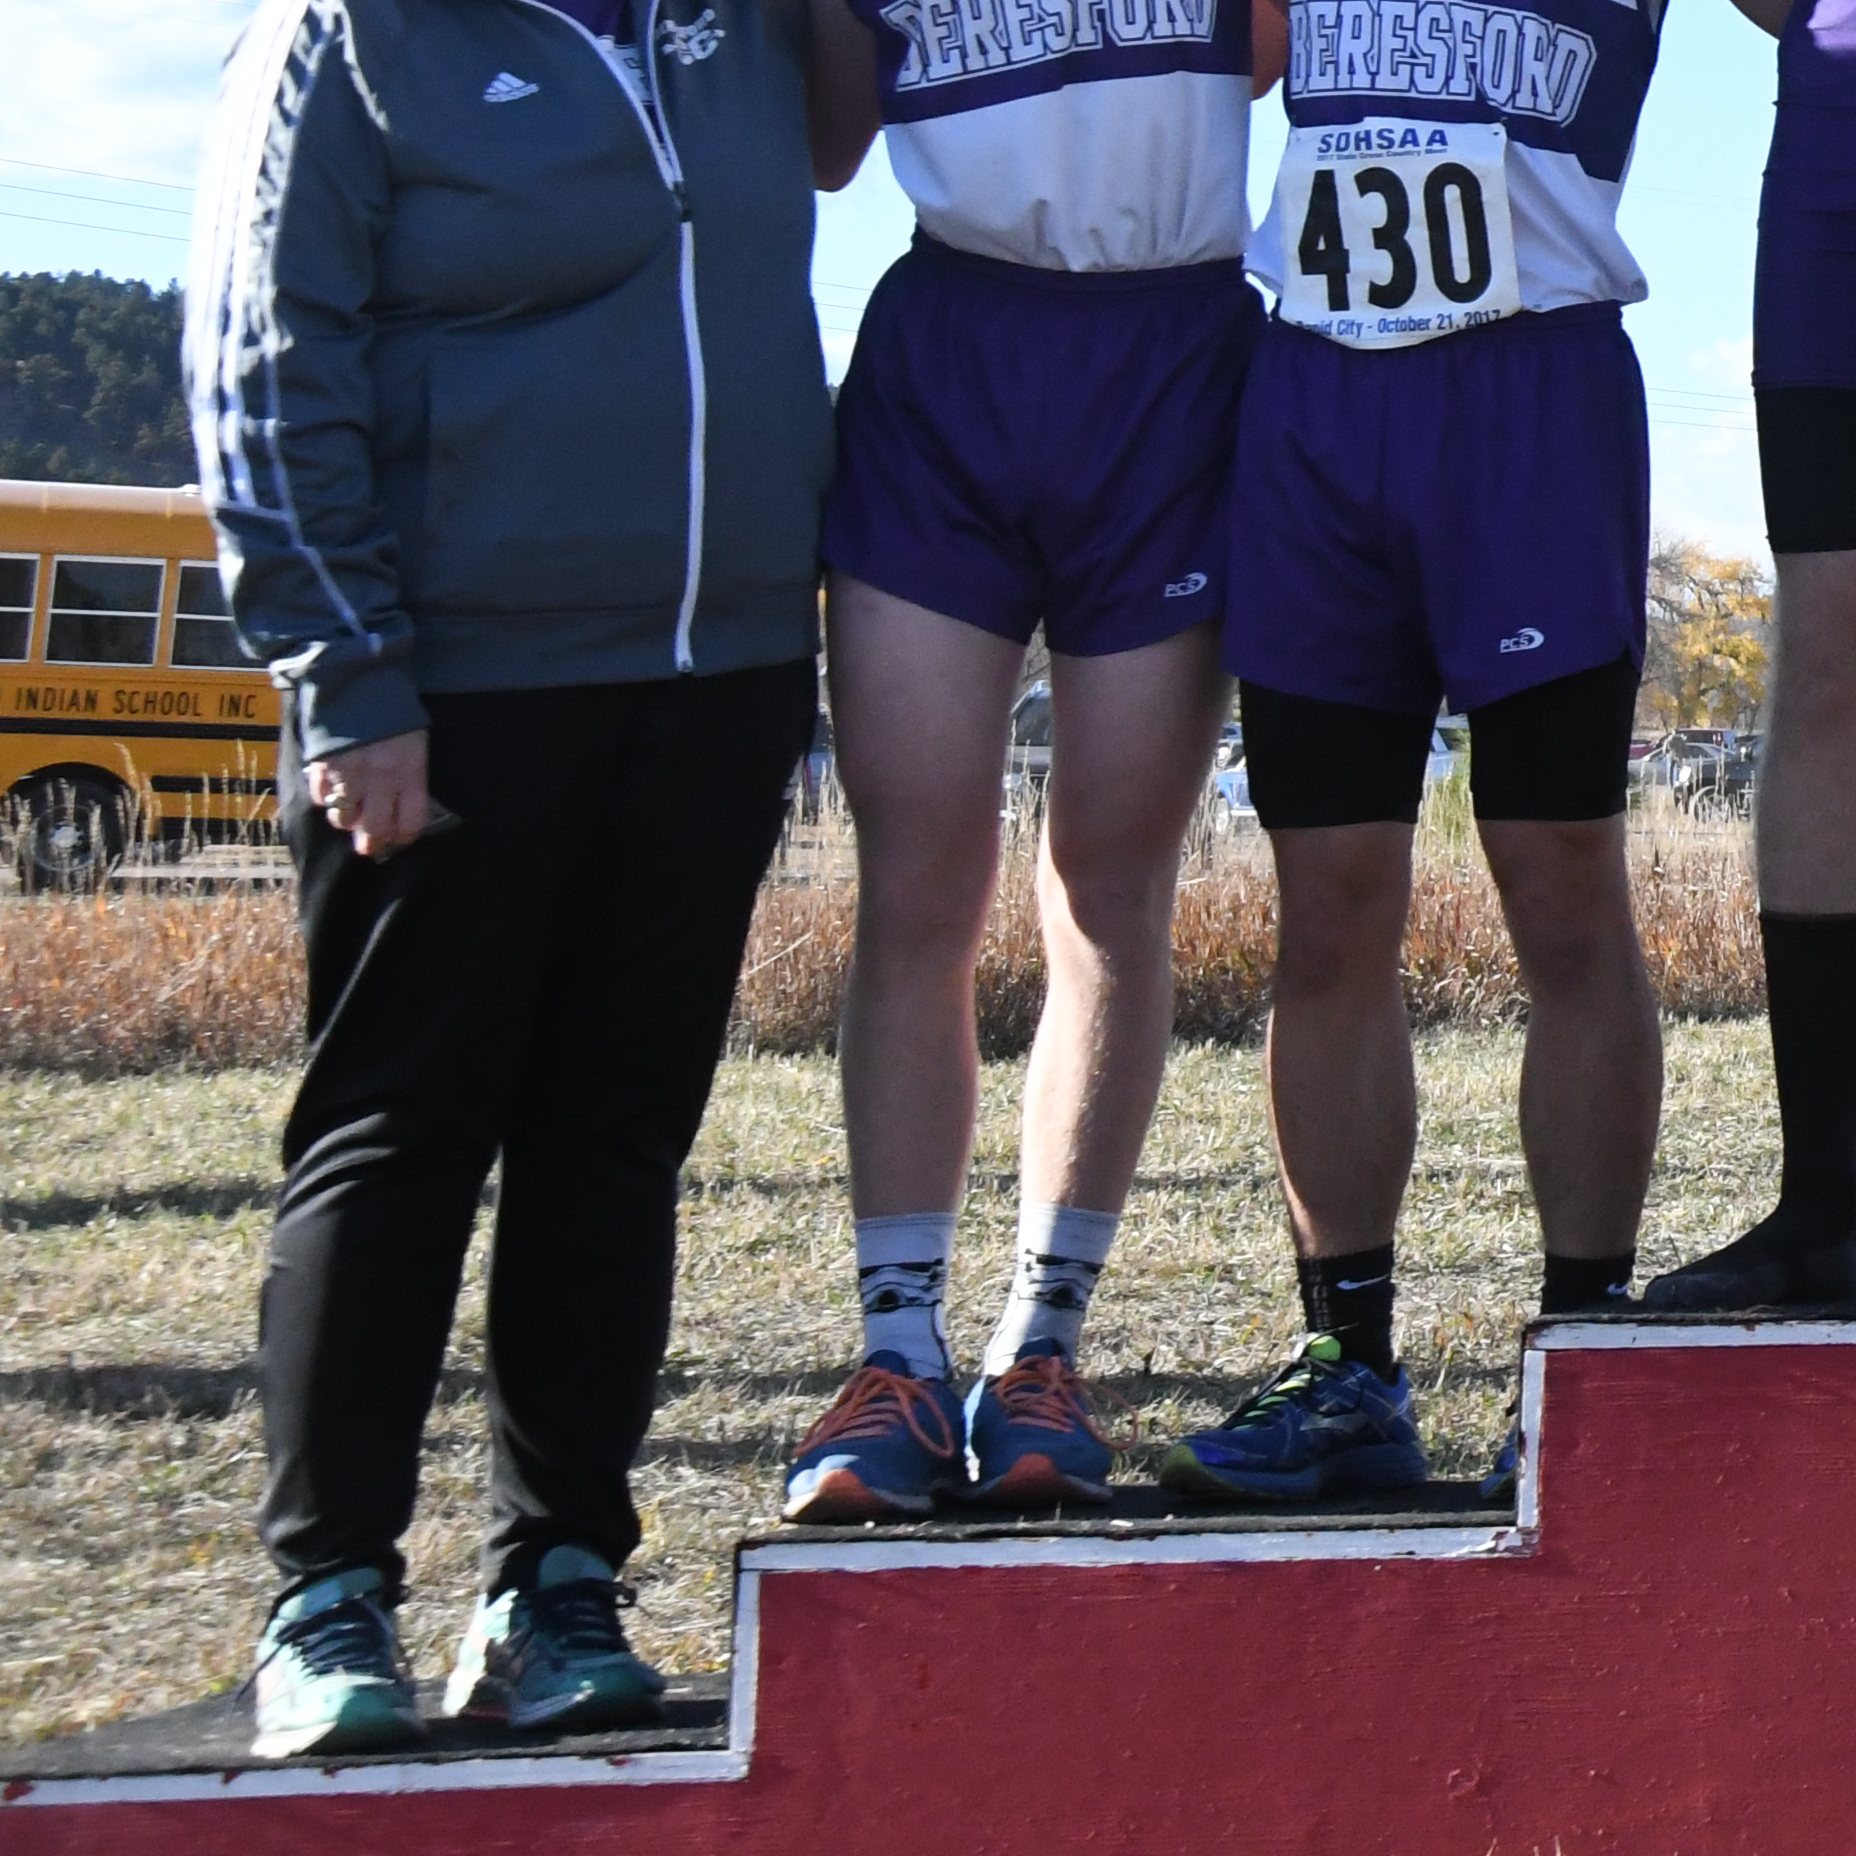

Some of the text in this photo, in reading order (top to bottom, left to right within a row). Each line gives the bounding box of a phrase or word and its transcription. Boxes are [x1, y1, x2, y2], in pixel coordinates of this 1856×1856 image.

[1317, 128, 1449, 153] SDHSAA
[1298, 162, 1492, 312] 430
[1337, 319, 1364, 338] City
[1377, 316, 1432, 333] October
[1436, 313, 1460, 330] 21,
[15, 687, 257, 719] INDIAN SCHOOL INC
